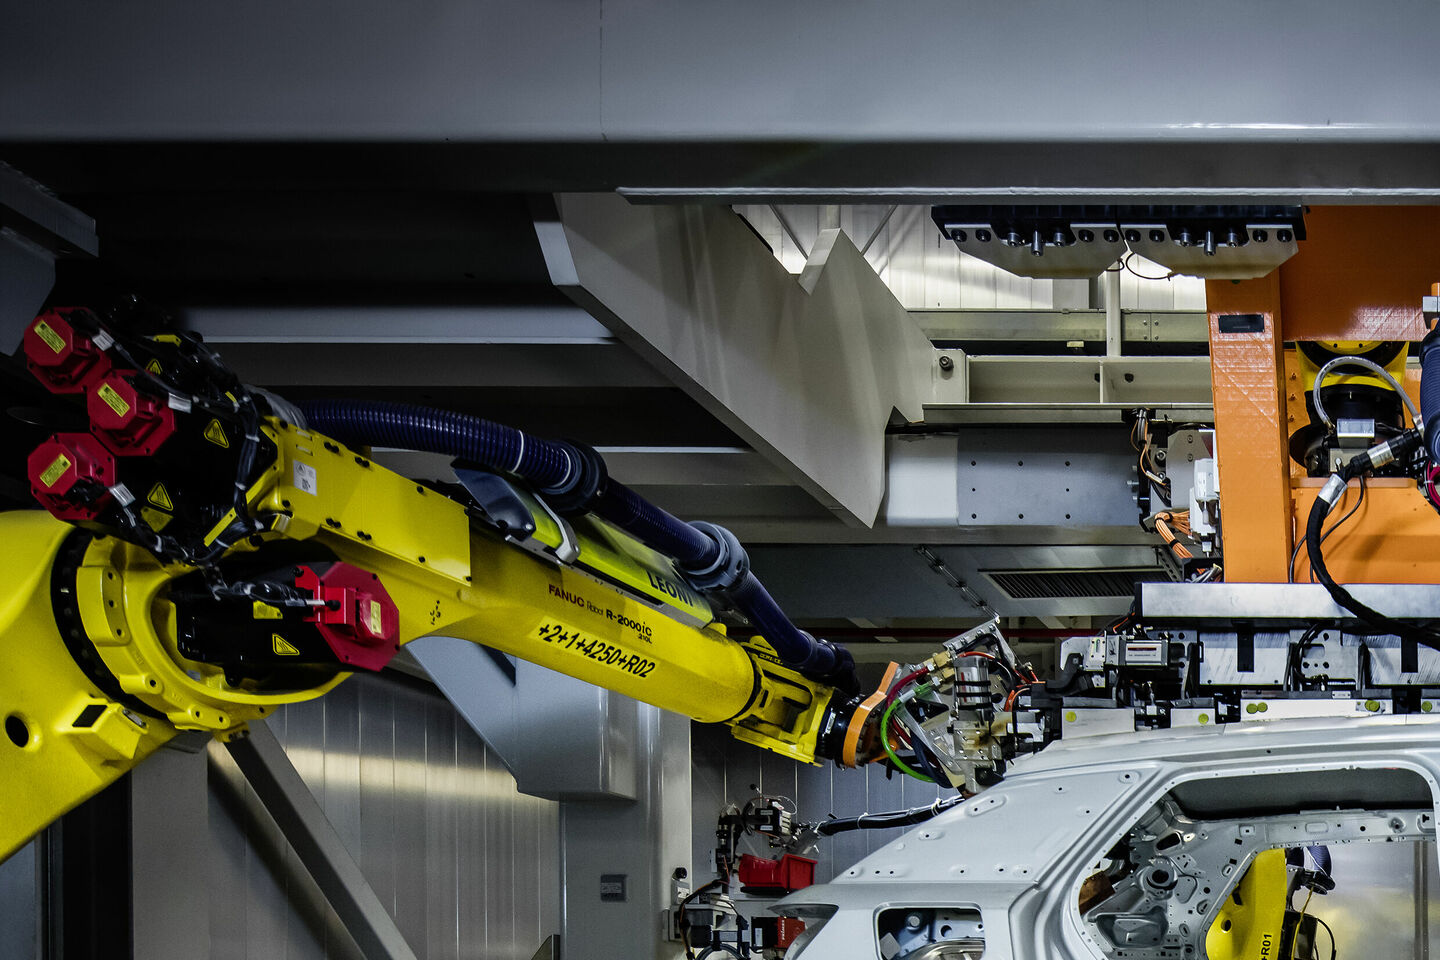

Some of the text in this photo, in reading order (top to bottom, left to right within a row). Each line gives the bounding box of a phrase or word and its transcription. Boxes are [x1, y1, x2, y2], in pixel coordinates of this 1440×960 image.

[548, 583, 585, 608] FANUC
[646, 570, 694, 607] LEONI
[538, 623, 656, 678] +2+1+4250+R02
